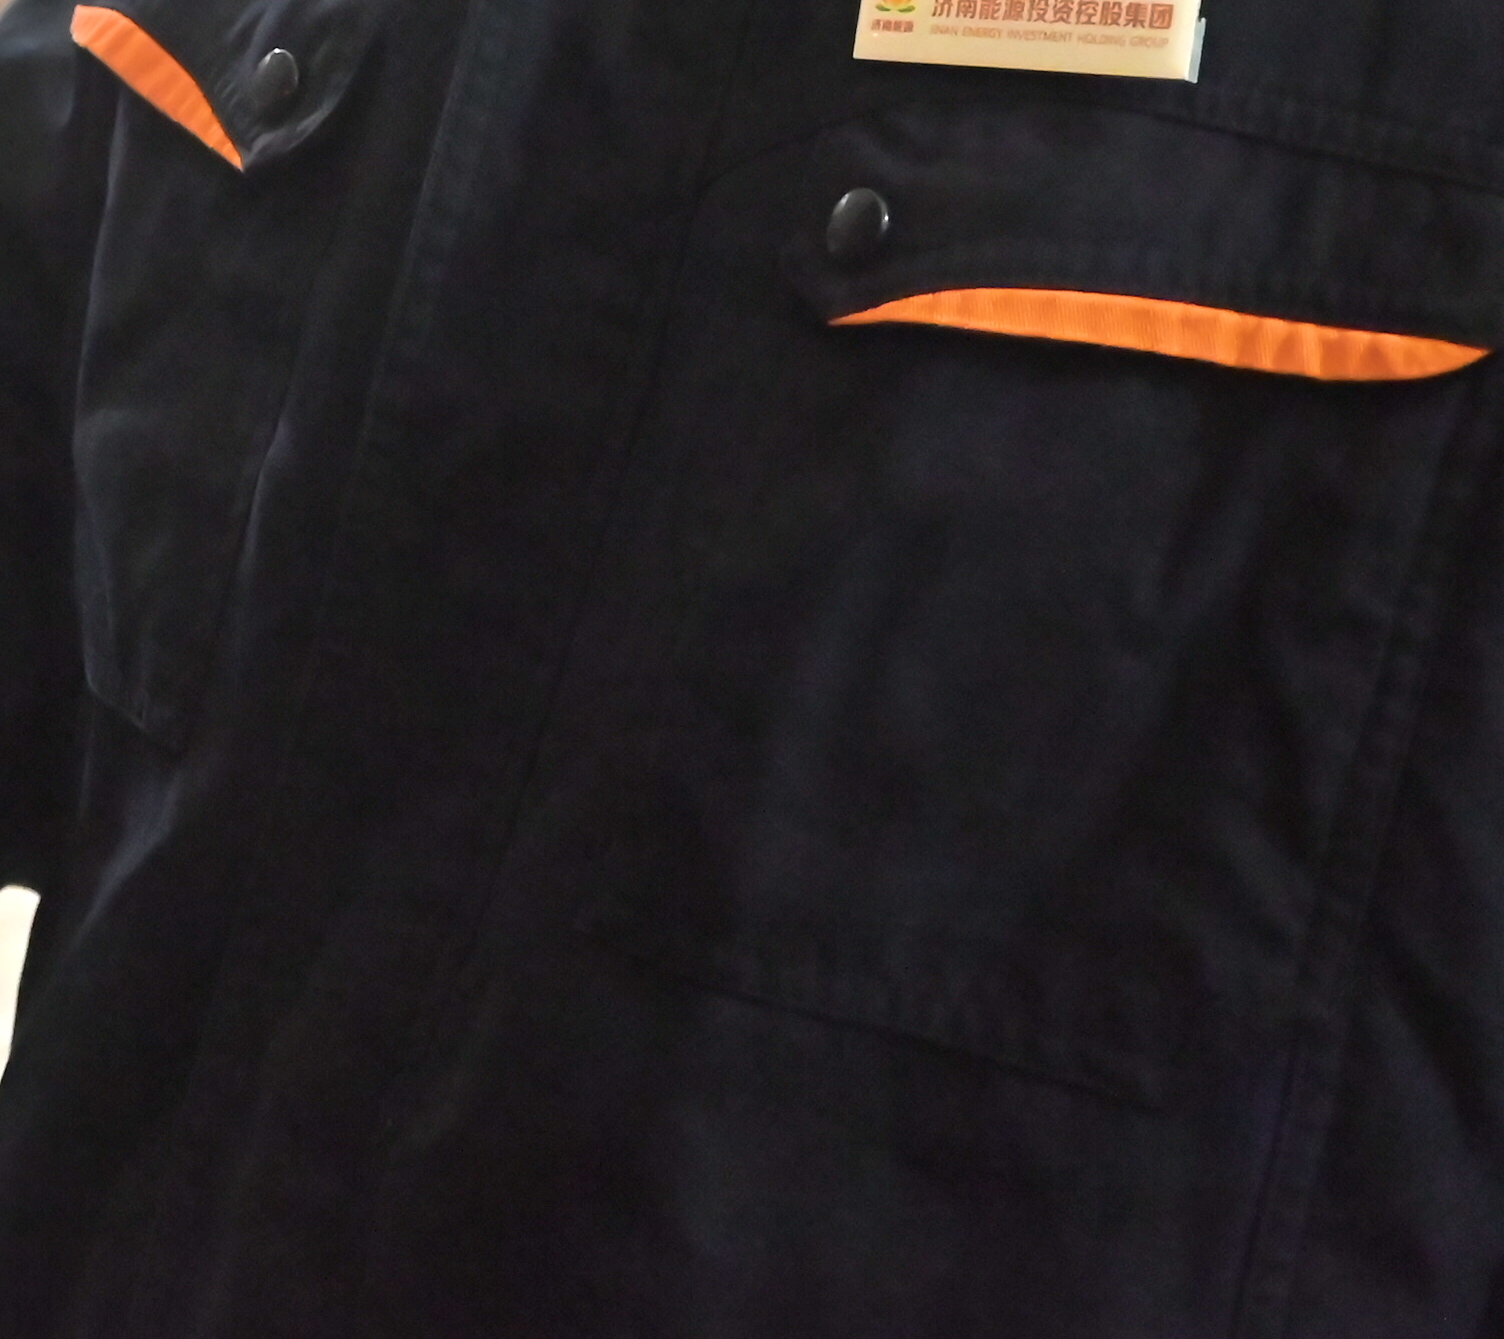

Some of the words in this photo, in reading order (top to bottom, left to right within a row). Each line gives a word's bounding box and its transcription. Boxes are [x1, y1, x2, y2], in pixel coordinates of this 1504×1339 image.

[962, 25, 1003, 39] ENERGY
[1006, 28, 1073, 43] INVESTMENT
[1077, 33, 1127, 47] HOLDING
[1129, 35, 1169, 49] GROUP
